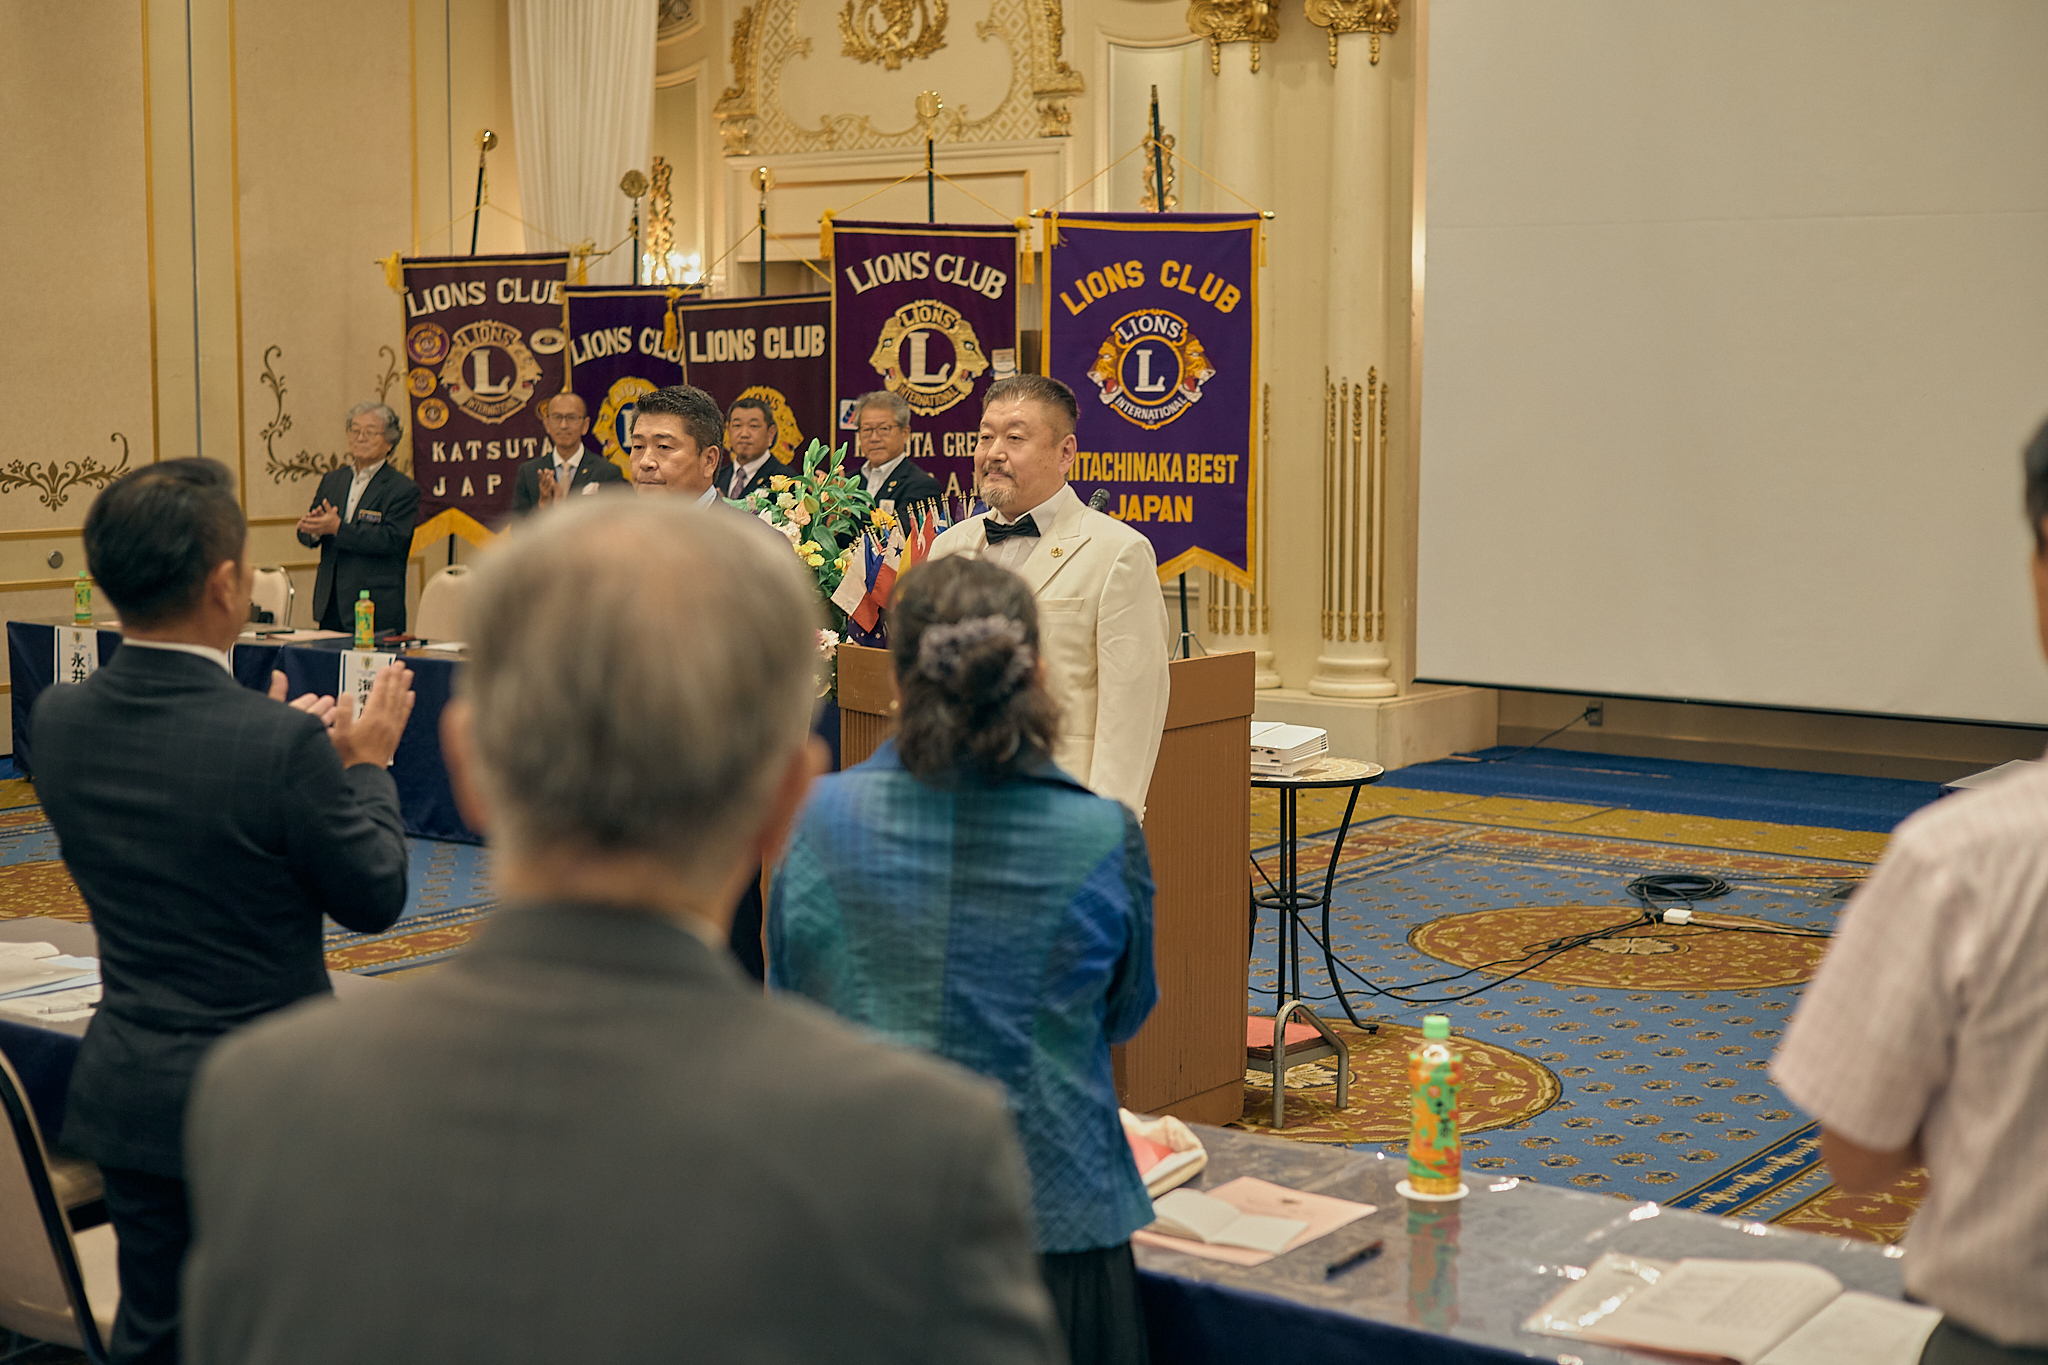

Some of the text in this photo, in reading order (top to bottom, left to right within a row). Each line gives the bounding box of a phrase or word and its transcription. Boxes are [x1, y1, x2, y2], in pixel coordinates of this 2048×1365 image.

[845, 251, 1008, 300] LIONS CLUB
[1059, 260, 1241, 316] LIONS CLUB
[406, 280, 487, 318] LIONS
[901, 306, 957, 328] LIONS
[1117, 315, 1182, 342] LIONS
[458, 325, 517, 346] LIONS
[570, 325, 633, 367] LIONS
[638, 326, 686, 367] CLU
[689, 324, 826, 363] LIONS CLUB
[471, 349, 511, 395] L
[907, 331, 951, 384] L
[1134, 349, 1166, 393] L
[1114, 396, 1188, 420] INTERNATIONAL
[431, 436, 553, 463] KATSUTA
[432, 474, 503, 497] JAP
[1186, 453, 1239, 484] BEST
[1109, 494, 1194, 523] JAPAN
